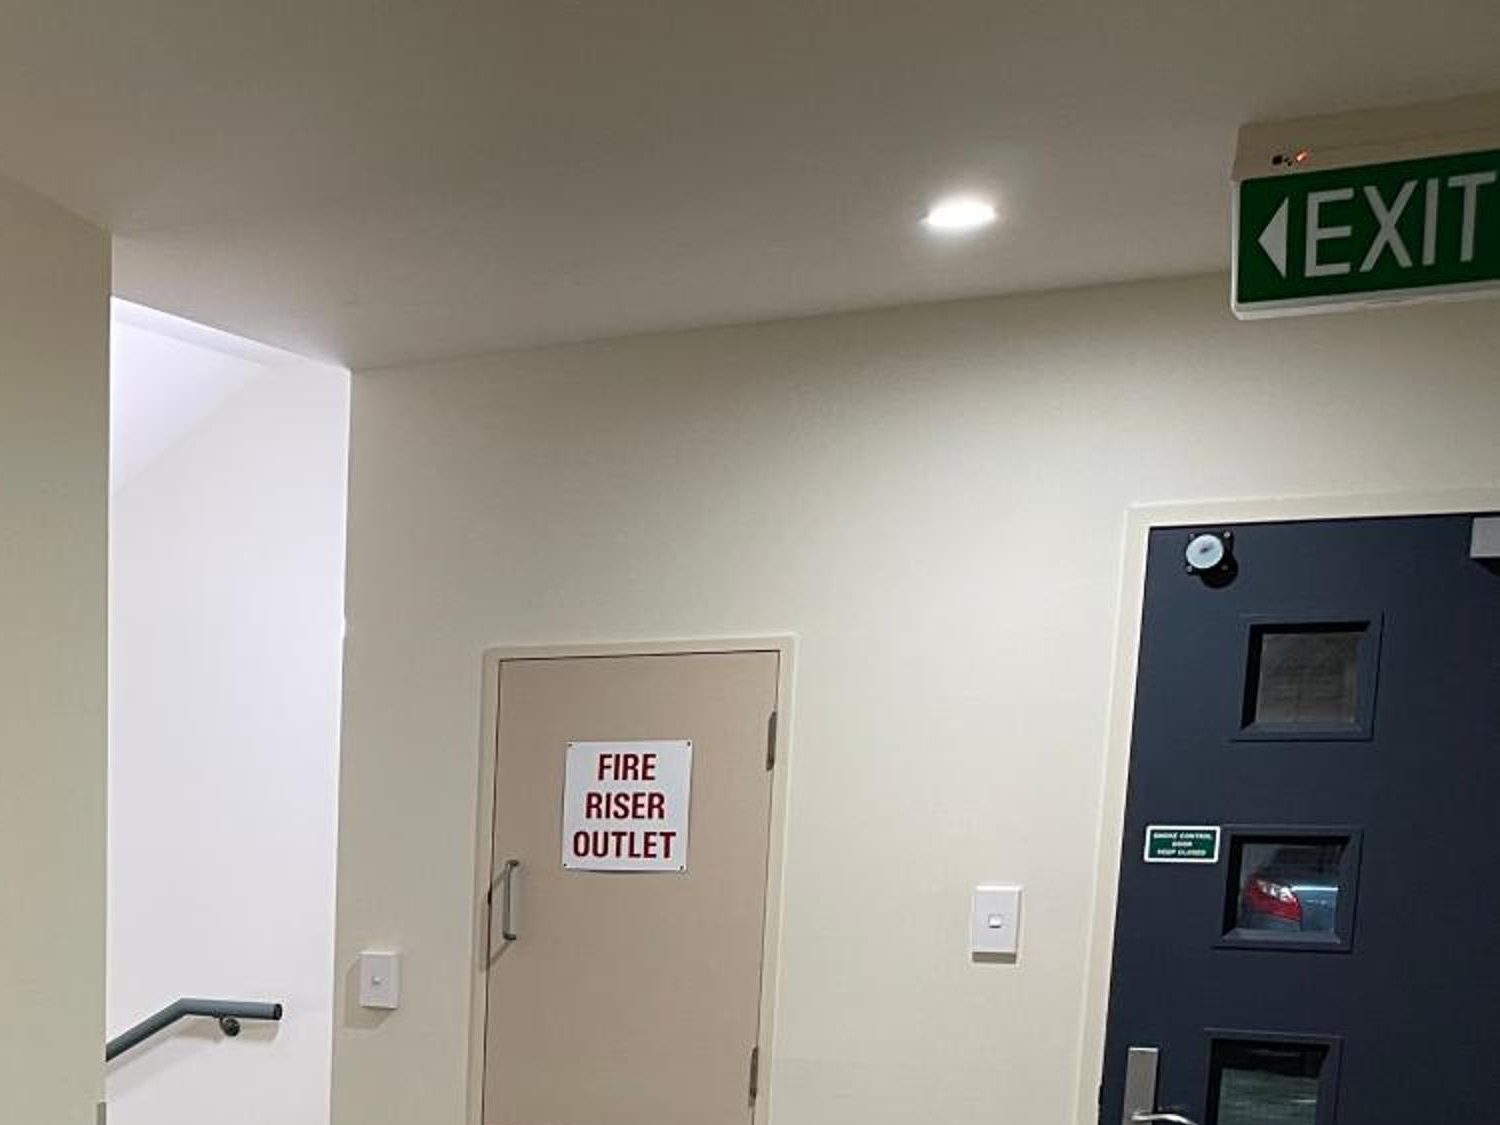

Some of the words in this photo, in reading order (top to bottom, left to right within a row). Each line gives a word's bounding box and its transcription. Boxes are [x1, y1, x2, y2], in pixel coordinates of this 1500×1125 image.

[1304, 170, 1497, 278] EXIT
[597, 753, 657, 781] FIRE
[585, 792, 665, 819] RISER
[573, 831, 677, 859] OUTLET
